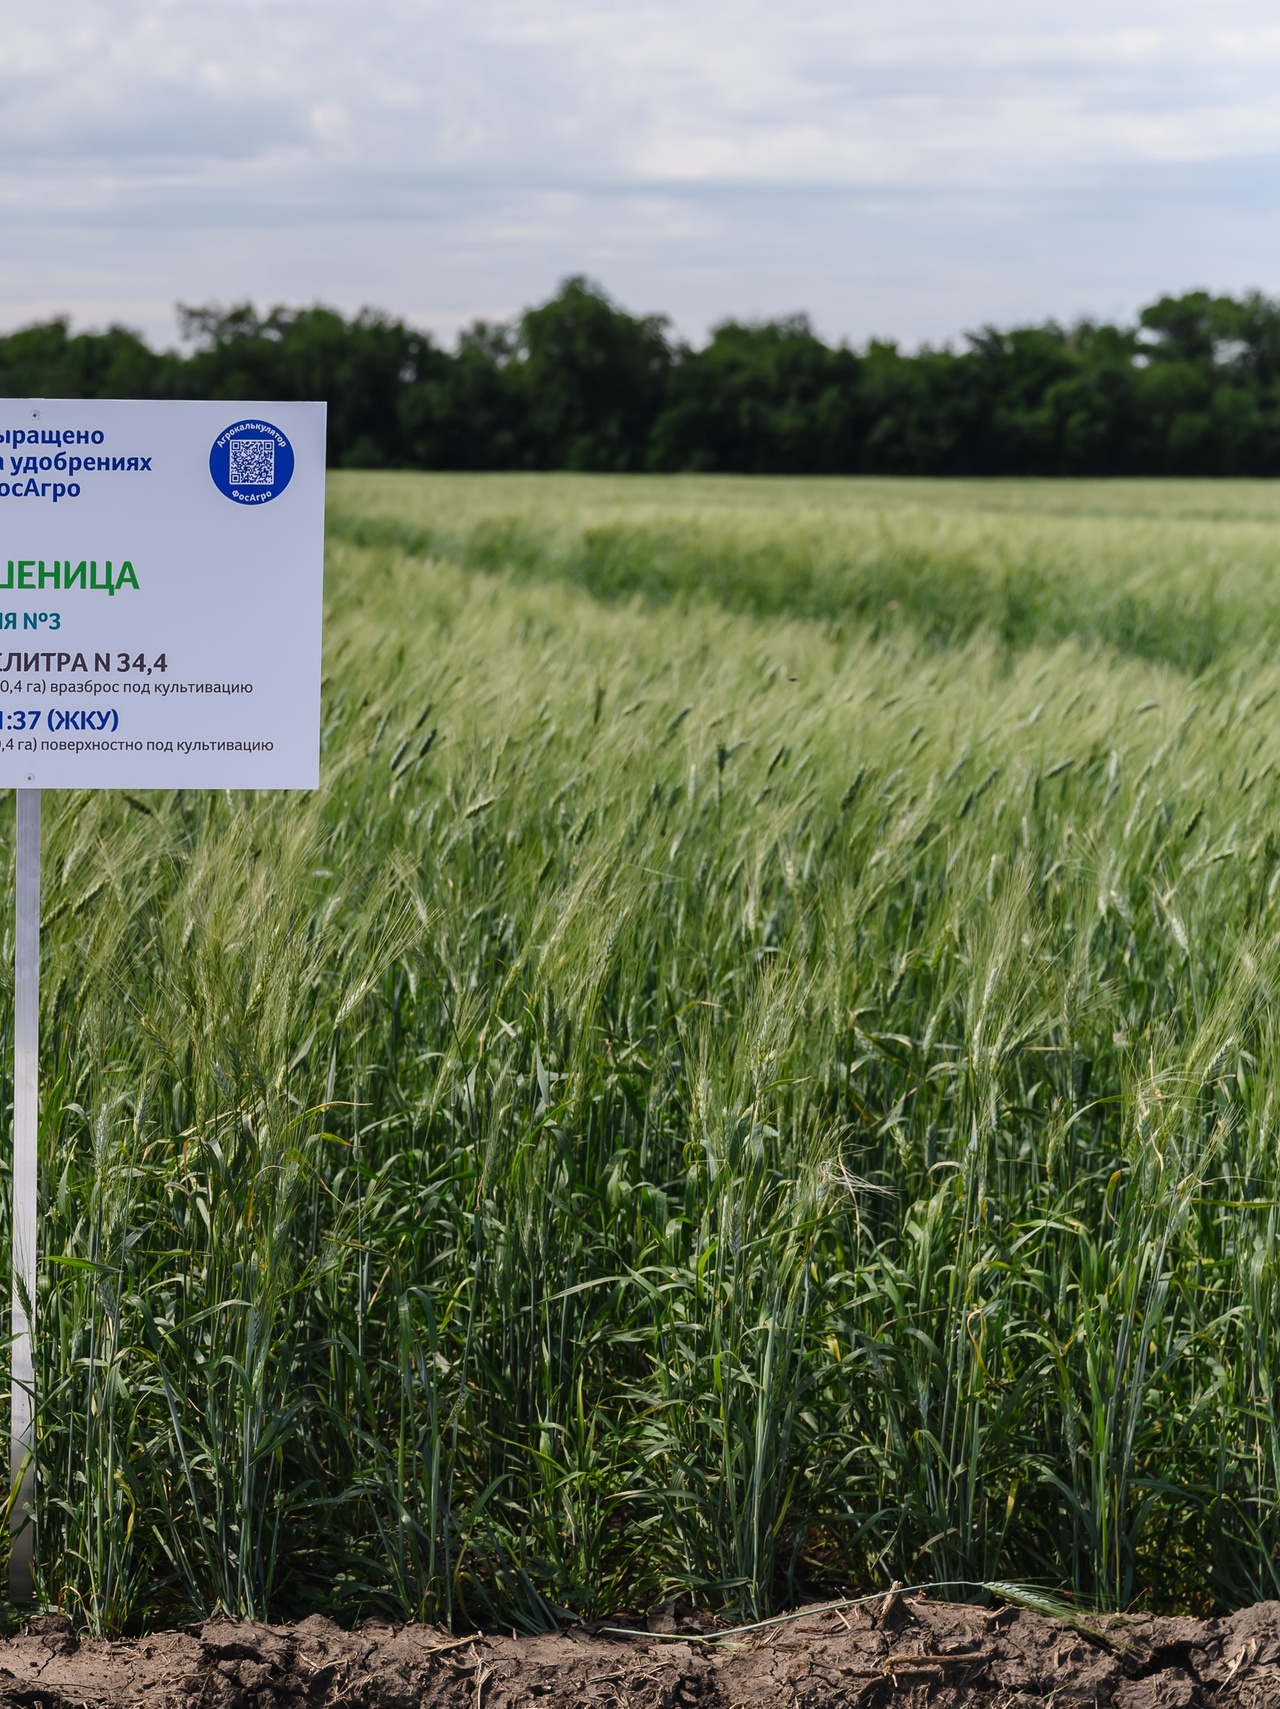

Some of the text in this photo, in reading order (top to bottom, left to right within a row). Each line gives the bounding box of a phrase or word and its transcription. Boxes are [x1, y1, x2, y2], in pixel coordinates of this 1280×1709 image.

[216, 422, 287, 449] Агрокалькулятор
[9, 451, 153, 476] удобрениях
[231, 489, 273, 502] ФосАгро
[94, 652, 111, 673] N
[116, 652, 168, 676] 34,4
[0, 679, 23, 695] 0,4
[26, 678, 47, 695] га)
[50, 679, 120, 697] вразброс
[123, 683, 151, 695] под
[154, 683, 254, 697] культивацию
[47, 708, 119, 733] (ЖКУ)
[17, 736, 38, 753] га)
[40, 740, 143, 755] поверхностно
[146, 740, 174, 753] под
[176, 741, 274, 755] культивацию
